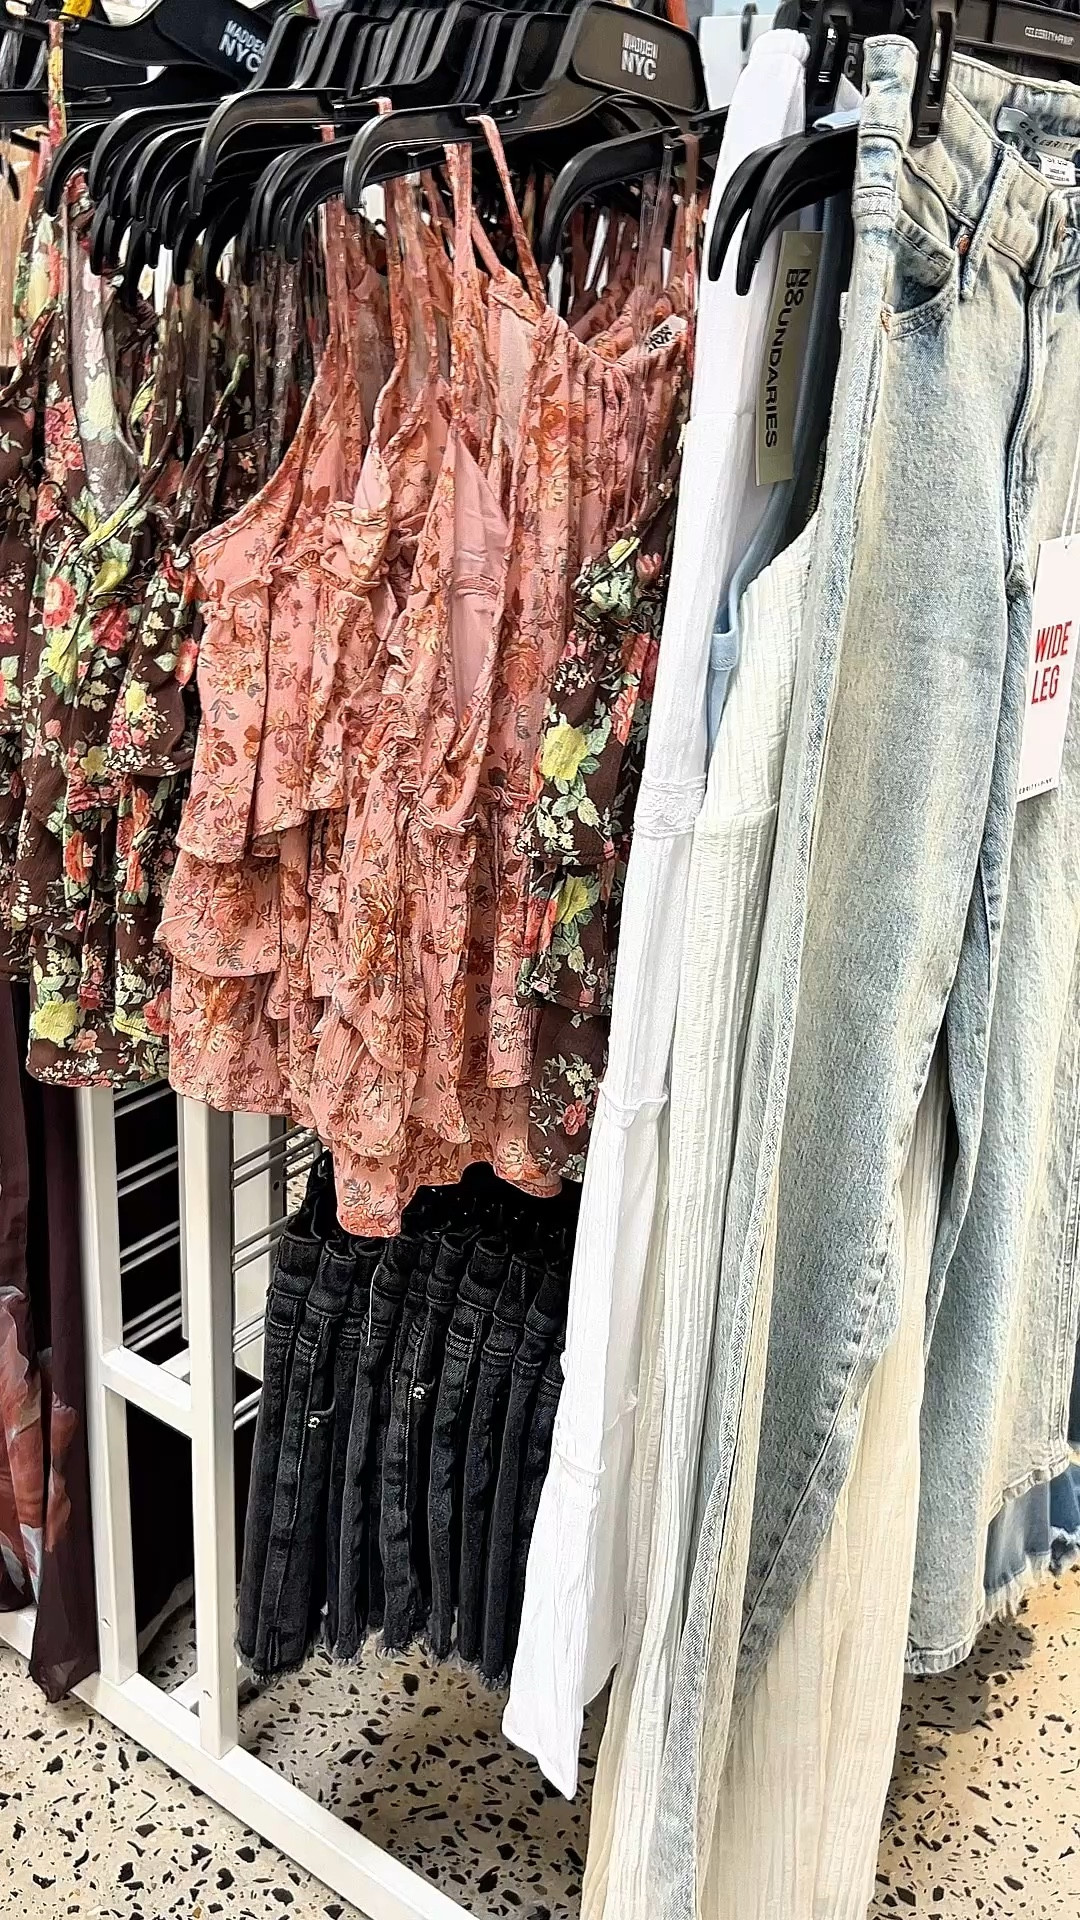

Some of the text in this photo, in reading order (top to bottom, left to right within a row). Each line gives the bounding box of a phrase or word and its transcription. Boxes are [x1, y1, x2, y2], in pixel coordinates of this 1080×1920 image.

[219, 33, 262, 73] NYC
[621, 49, 657, 80] NYC
[765, 267, 799, 448] BOUNDARIES
[1034, 620, 1072, 664] WIDE
[1031, 664, 1060, 705] LEG
